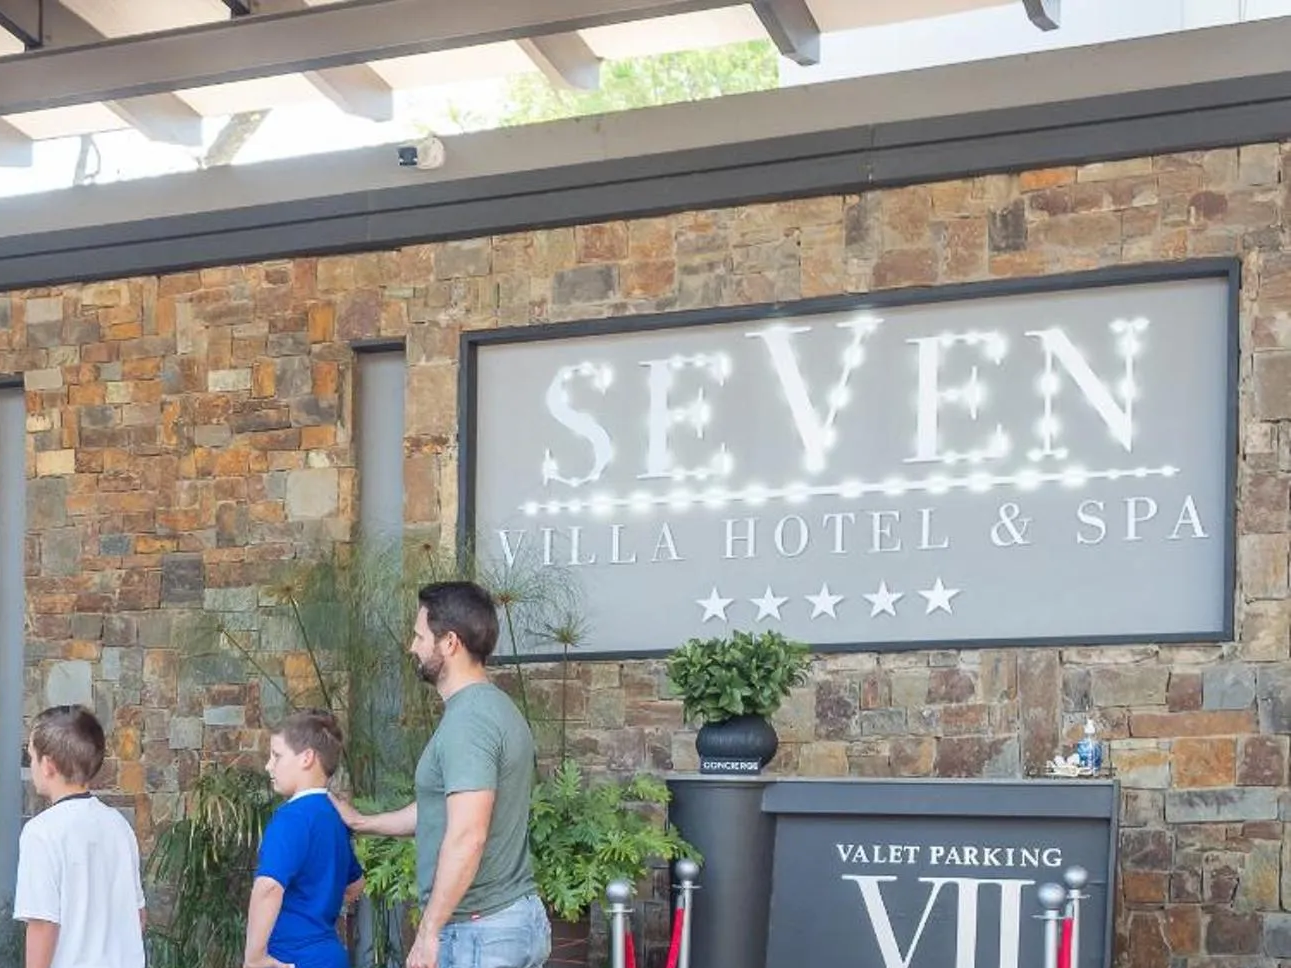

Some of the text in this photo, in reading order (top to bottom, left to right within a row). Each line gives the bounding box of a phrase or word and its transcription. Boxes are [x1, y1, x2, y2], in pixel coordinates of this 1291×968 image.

[541, 316, 1151, 487] SEVEN
[495, 494, 1209, 567] VILLA HOTEL & SPA
[703, 761, 759, 770] CONCIERGE
[836, 843, 1063, 868] VALET PARKING
